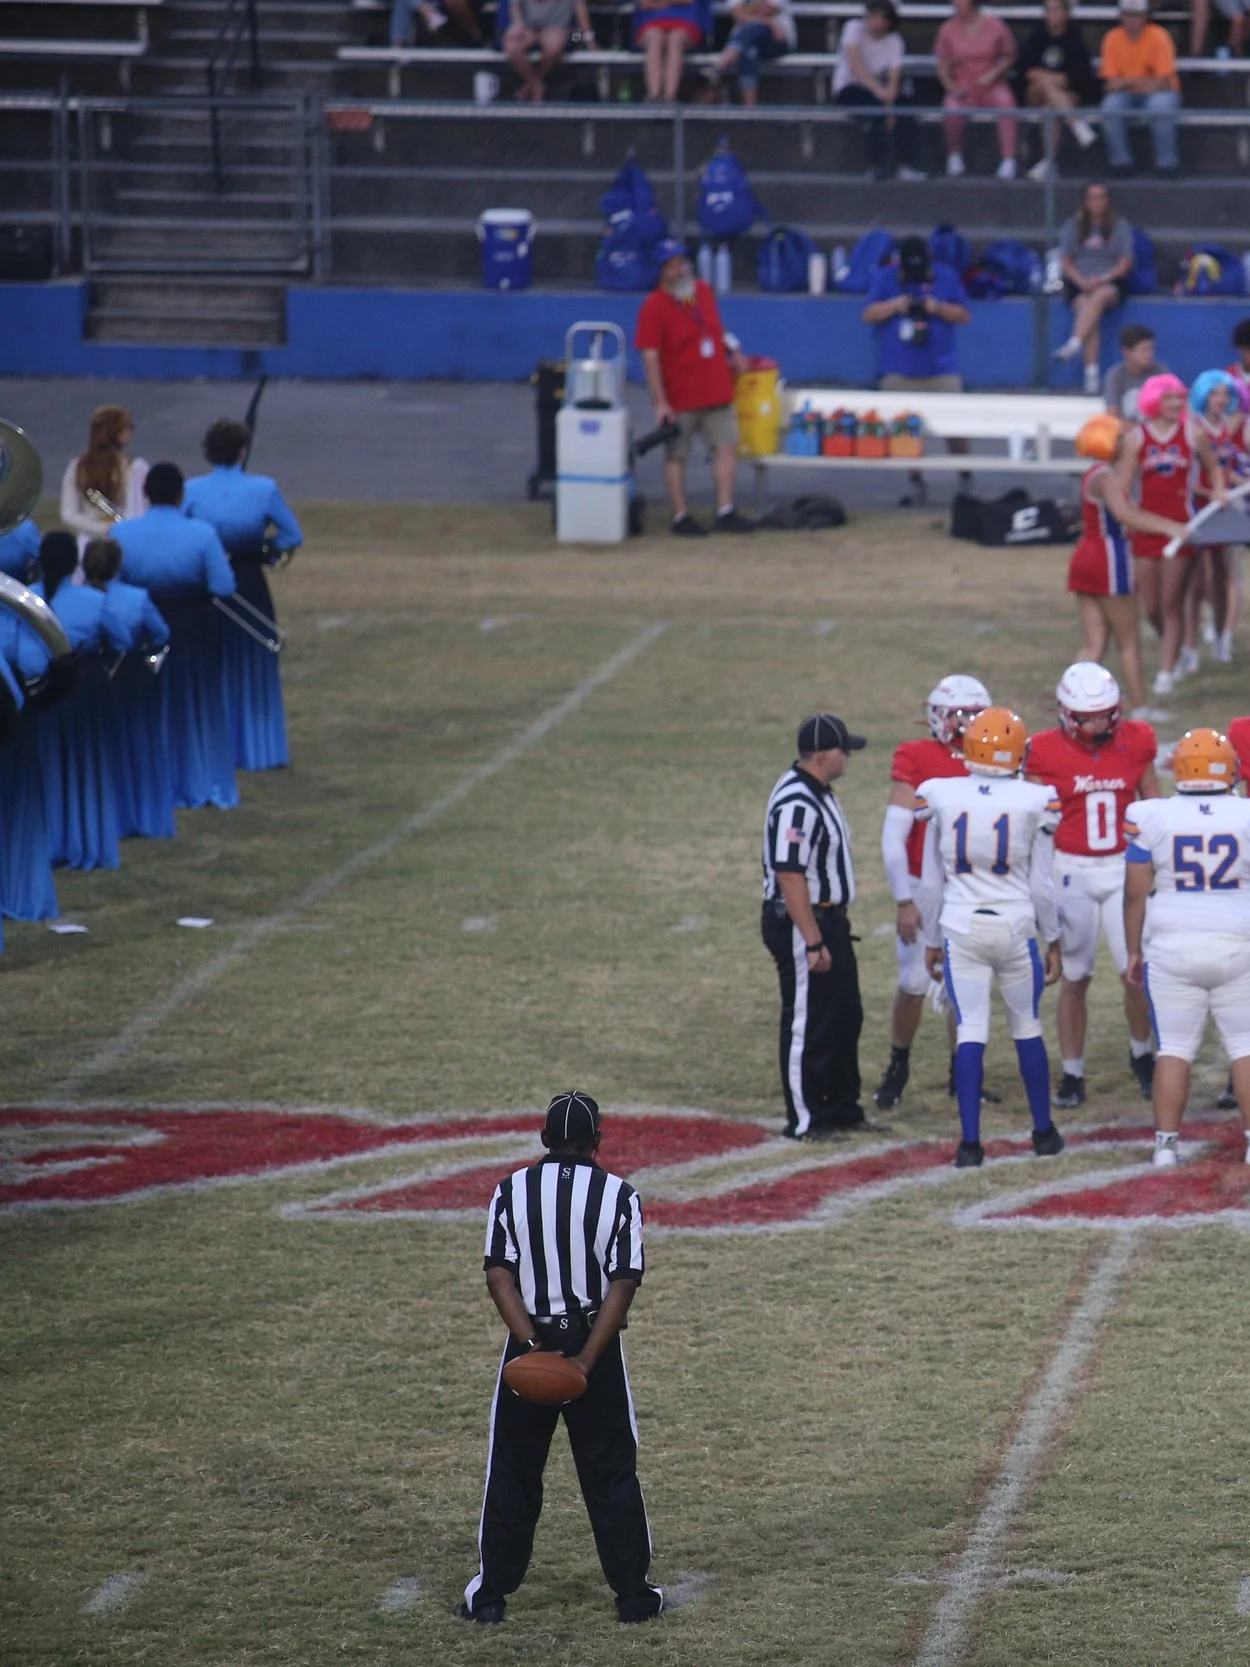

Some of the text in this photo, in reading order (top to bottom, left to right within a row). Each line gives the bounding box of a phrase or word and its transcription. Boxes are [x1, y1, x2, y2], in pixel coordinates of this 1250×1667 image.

[952, 811, 1010, 875] 11
[1086, 791, 1118, 850] 0
[1173, 833, 1240, 892] 52
[562, 1167, 571, 1177] S
[559, 1318, 569, 1330] S
